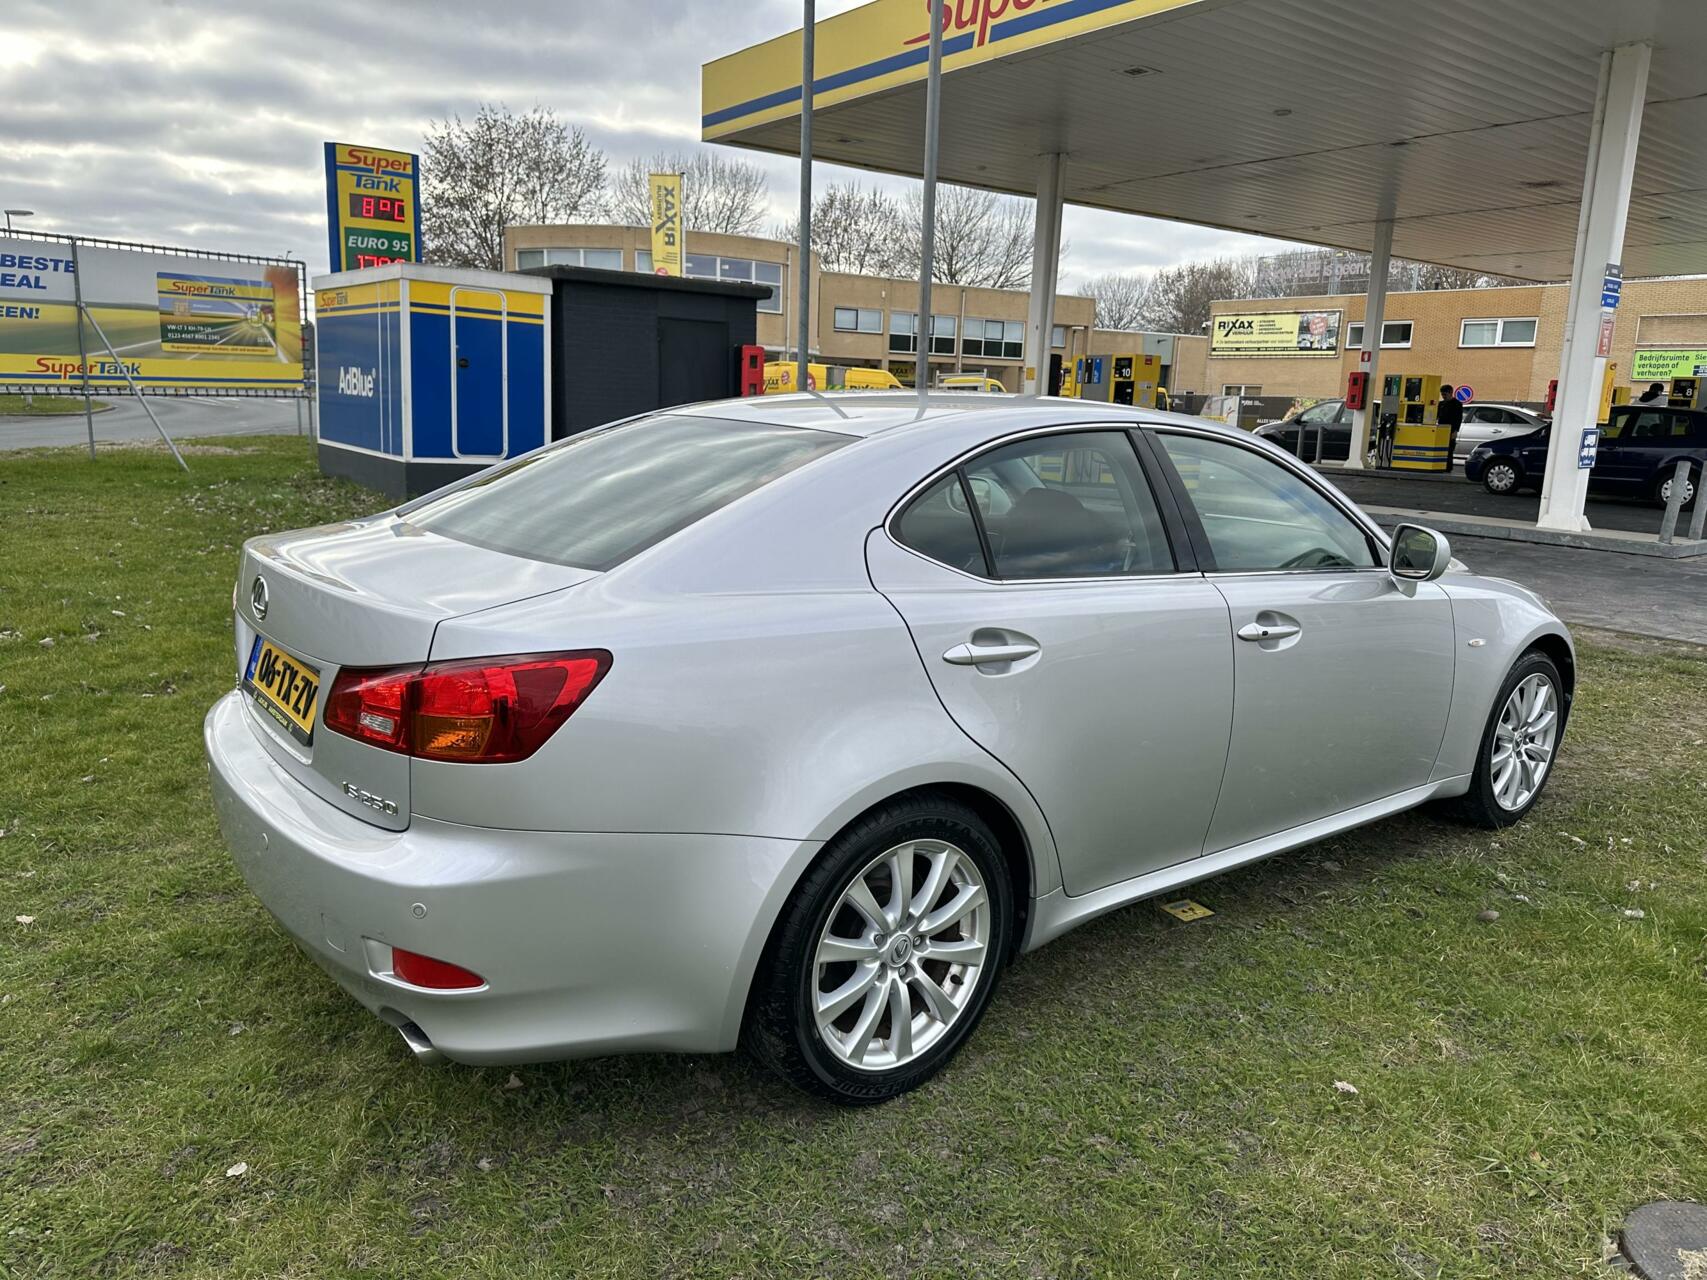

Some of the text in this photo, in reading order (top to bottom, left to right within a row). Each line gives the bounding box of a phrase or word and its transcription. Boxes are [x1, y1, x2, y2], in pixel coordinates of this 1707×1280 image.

[336, 148, 411, 175] Super
[349, 173, 401, 193] Tank
[348, 235, 409, 252] EURO 95
[0, 253, 75, 274] BESTE
[0, 273, 47, 290] EAL
[167, 281, 236, 296] SuperTank
[1218, 319, 1254, 337] RIXAX
[1637, 362, 1670, 370] verkopen
[1638, 354, 1690, 362] Bedrijfsruimte
[1122, 368, 1131, 377] 10
[1636, 369, 1672, 377] verhuren?
[1686, 388, 1693, 397] 8
[258, 648, 319, 720] 06-TX-ZV
